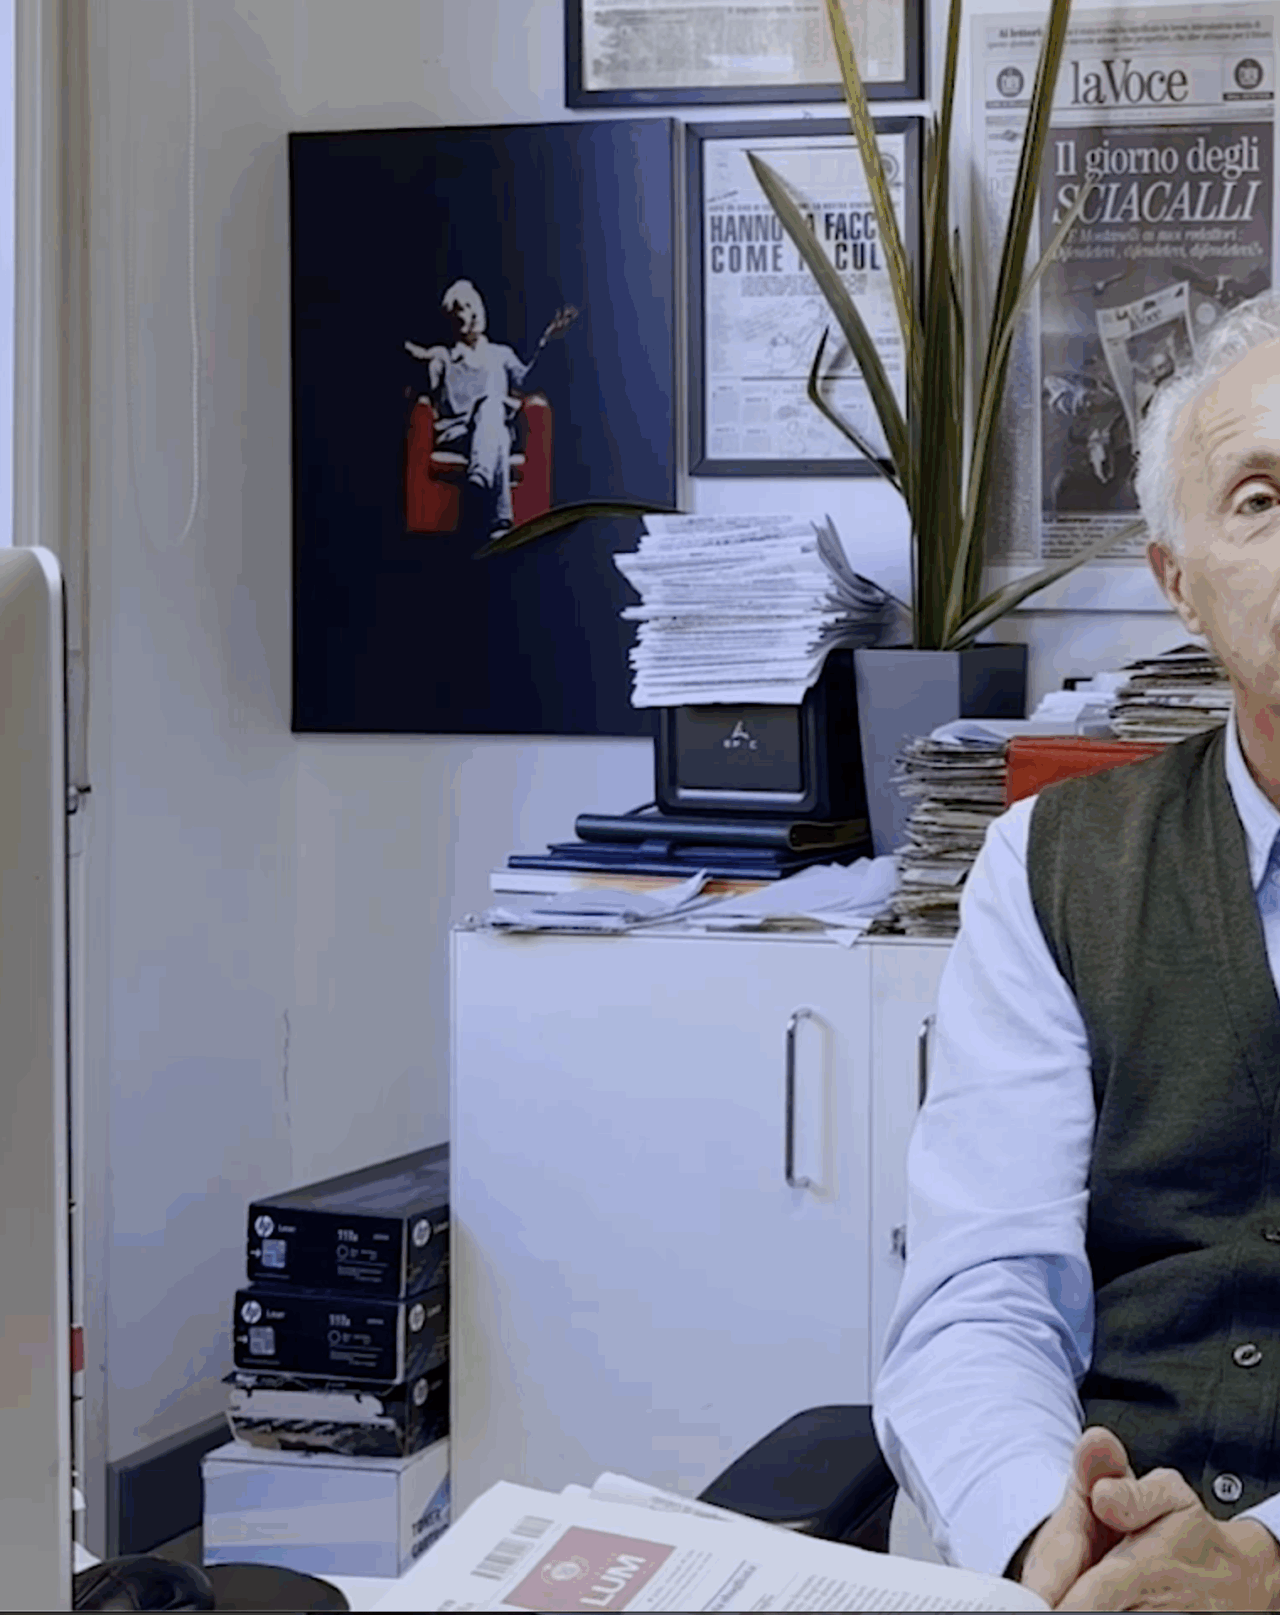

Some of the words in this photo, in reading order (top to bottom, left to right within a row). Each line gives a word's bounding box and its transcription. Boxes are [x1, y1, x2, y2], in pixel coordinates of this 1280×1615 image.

[1054, 140, 1077, 177] Il
[1085, 140, 1180, 183] giorno
[1186, 137, 1260, 180] degli
[1053, 181, 1262, 225] SCIACALLI
[824, 211, 877, 241] FACC
[711, 244, 784, 273] COME
[834, 242, 881, 271] CUL
[579, 1554, 647, 1607] LUM
